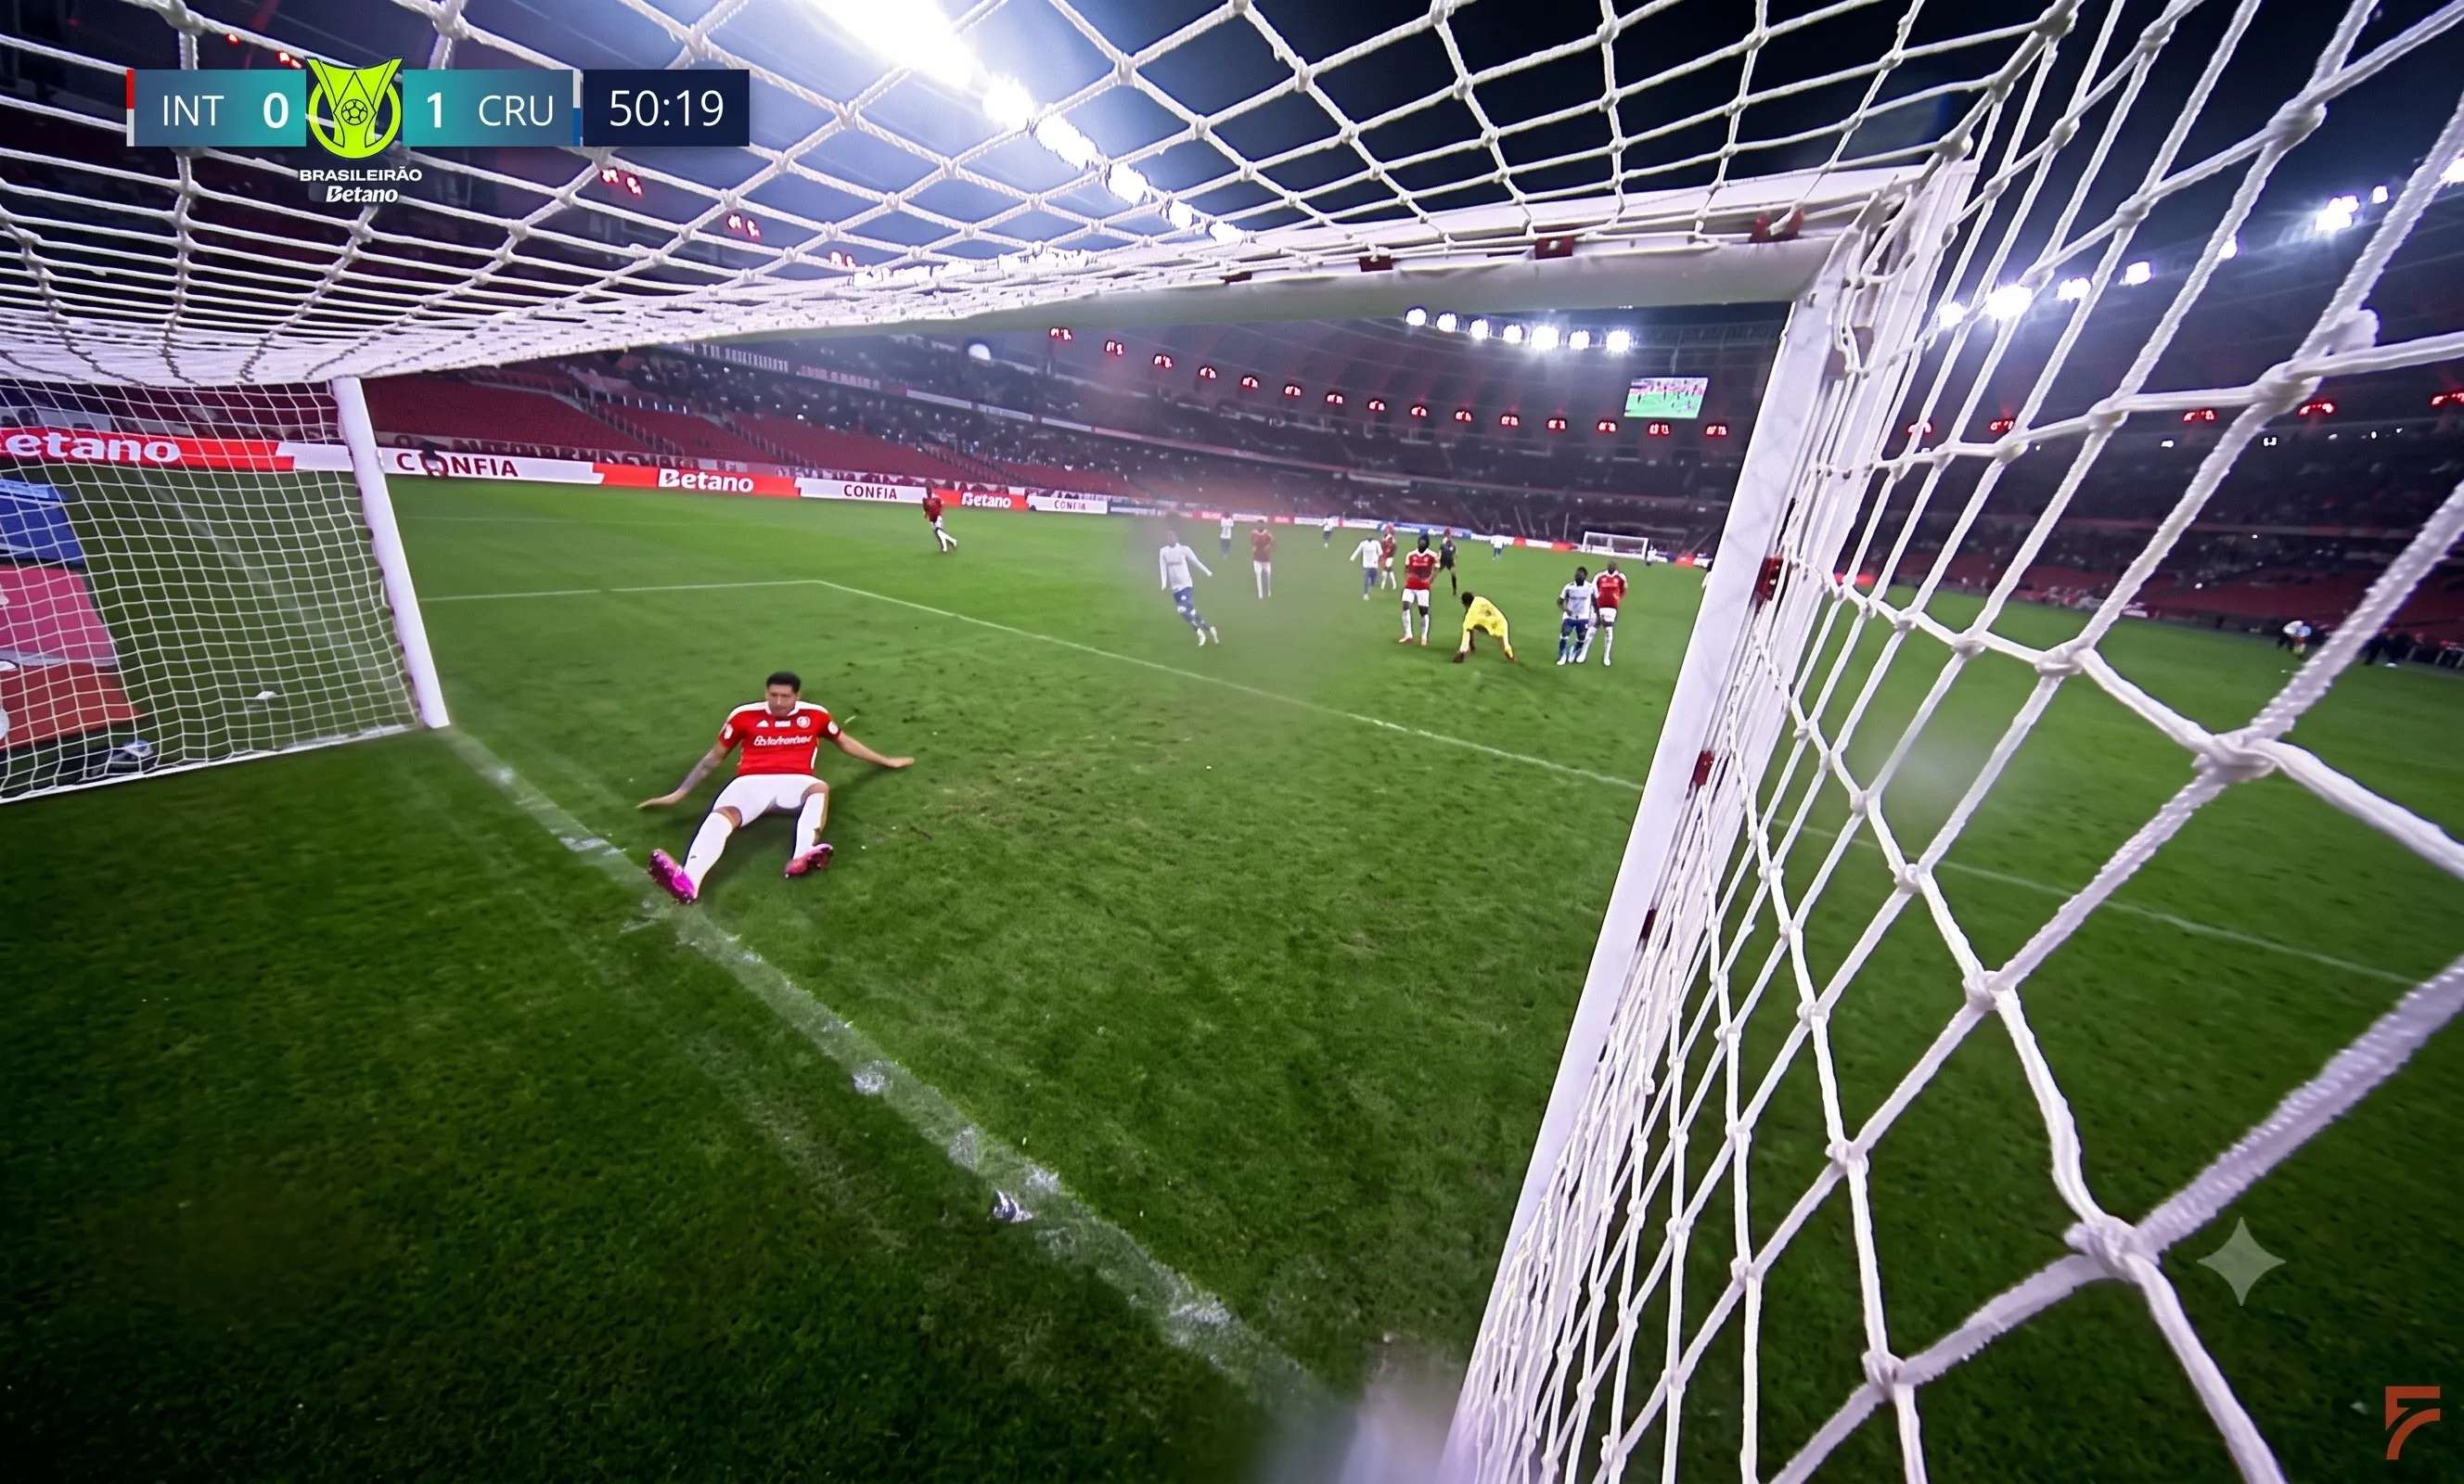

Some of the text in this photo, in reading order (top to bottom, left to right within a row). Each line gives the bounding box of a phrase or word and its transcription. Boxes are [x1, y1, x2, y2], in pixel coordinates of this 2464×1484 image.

[0, 431, 181, 463] etano
[658, 468, 754, 493] Betano
[843, 483, 898, 500] CONFIA
[961, 492, 1012, 508] Betano
